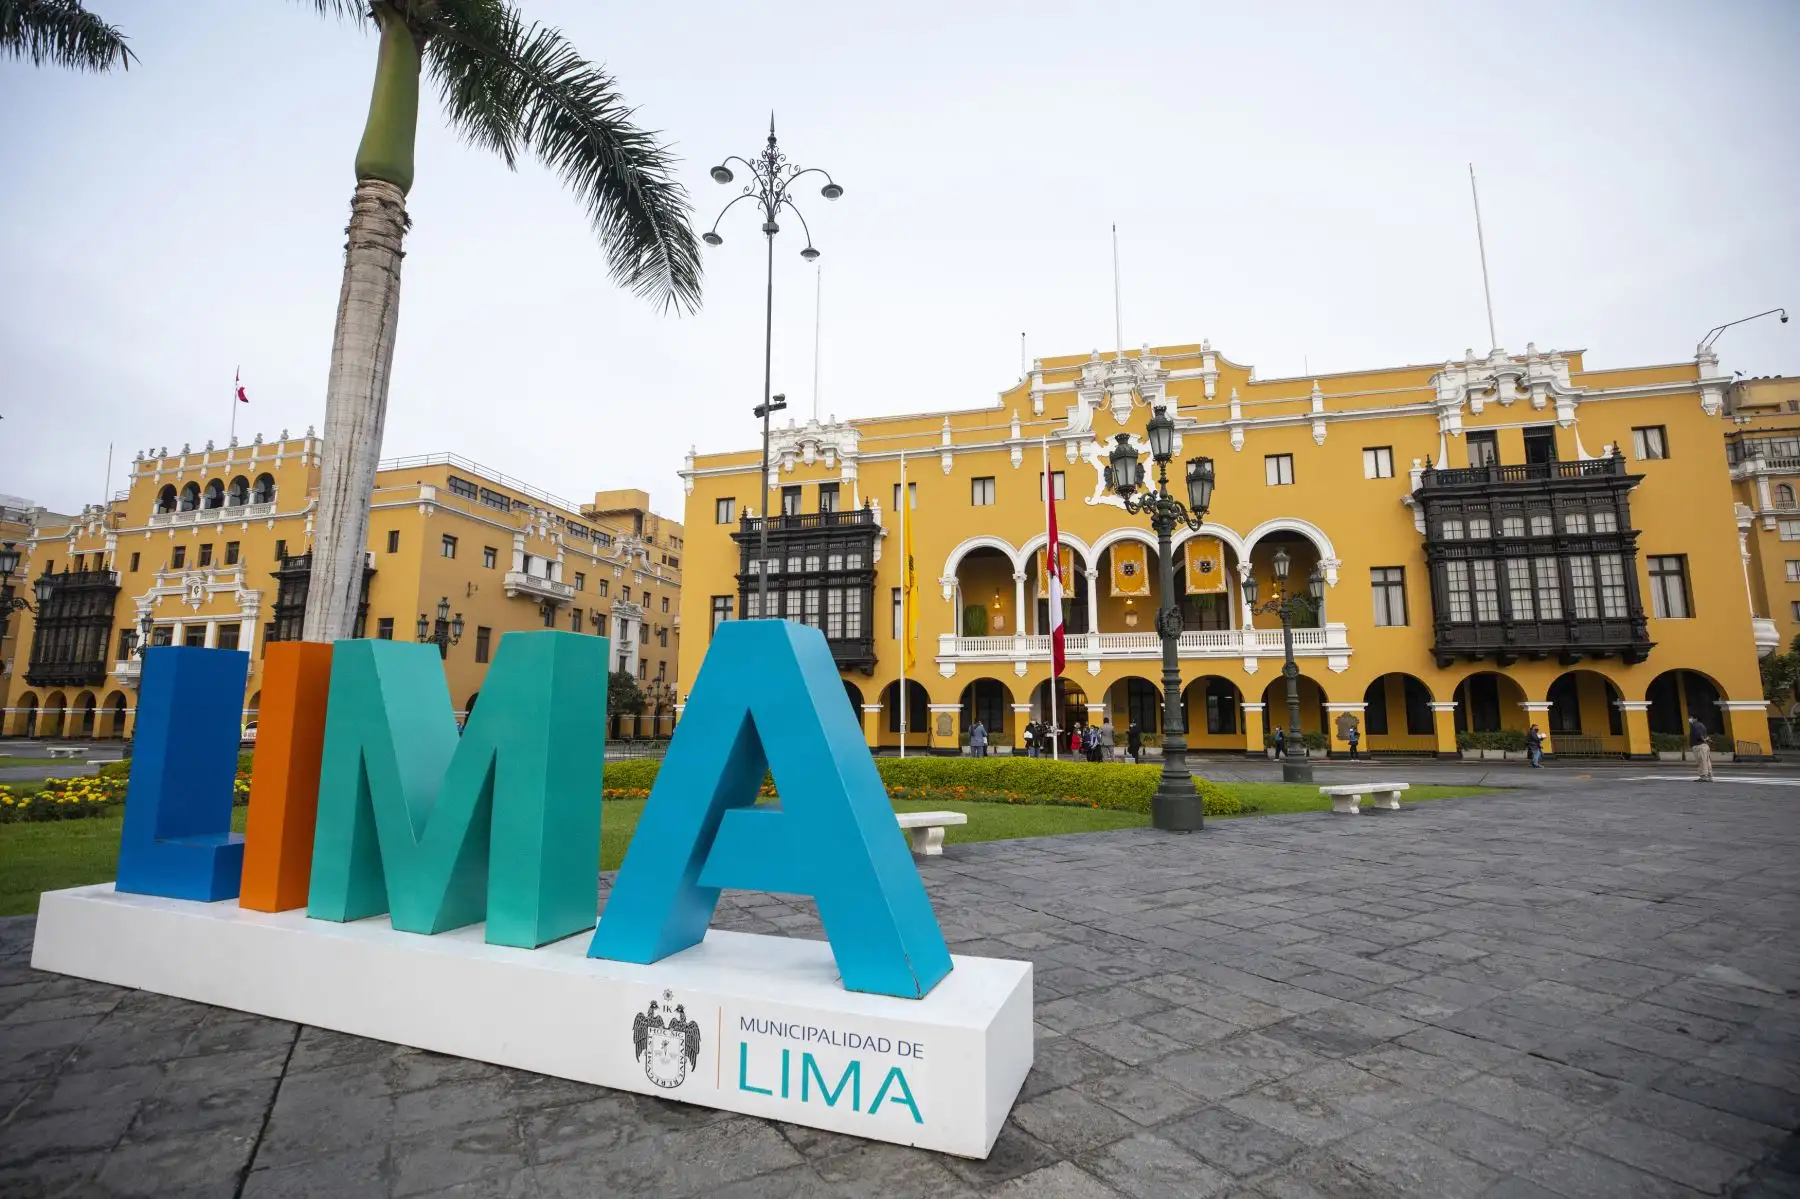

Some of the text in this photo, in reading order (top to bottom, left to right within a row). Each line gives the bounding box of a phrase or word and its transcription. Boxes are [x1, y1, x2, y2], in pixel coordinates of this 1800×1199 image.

[115, 619, 953, 999] LIMA
[740, 1016, 924, 1059] MUNICIPALIDAD DE
[739, 1042, 924, 1124] LIMA
